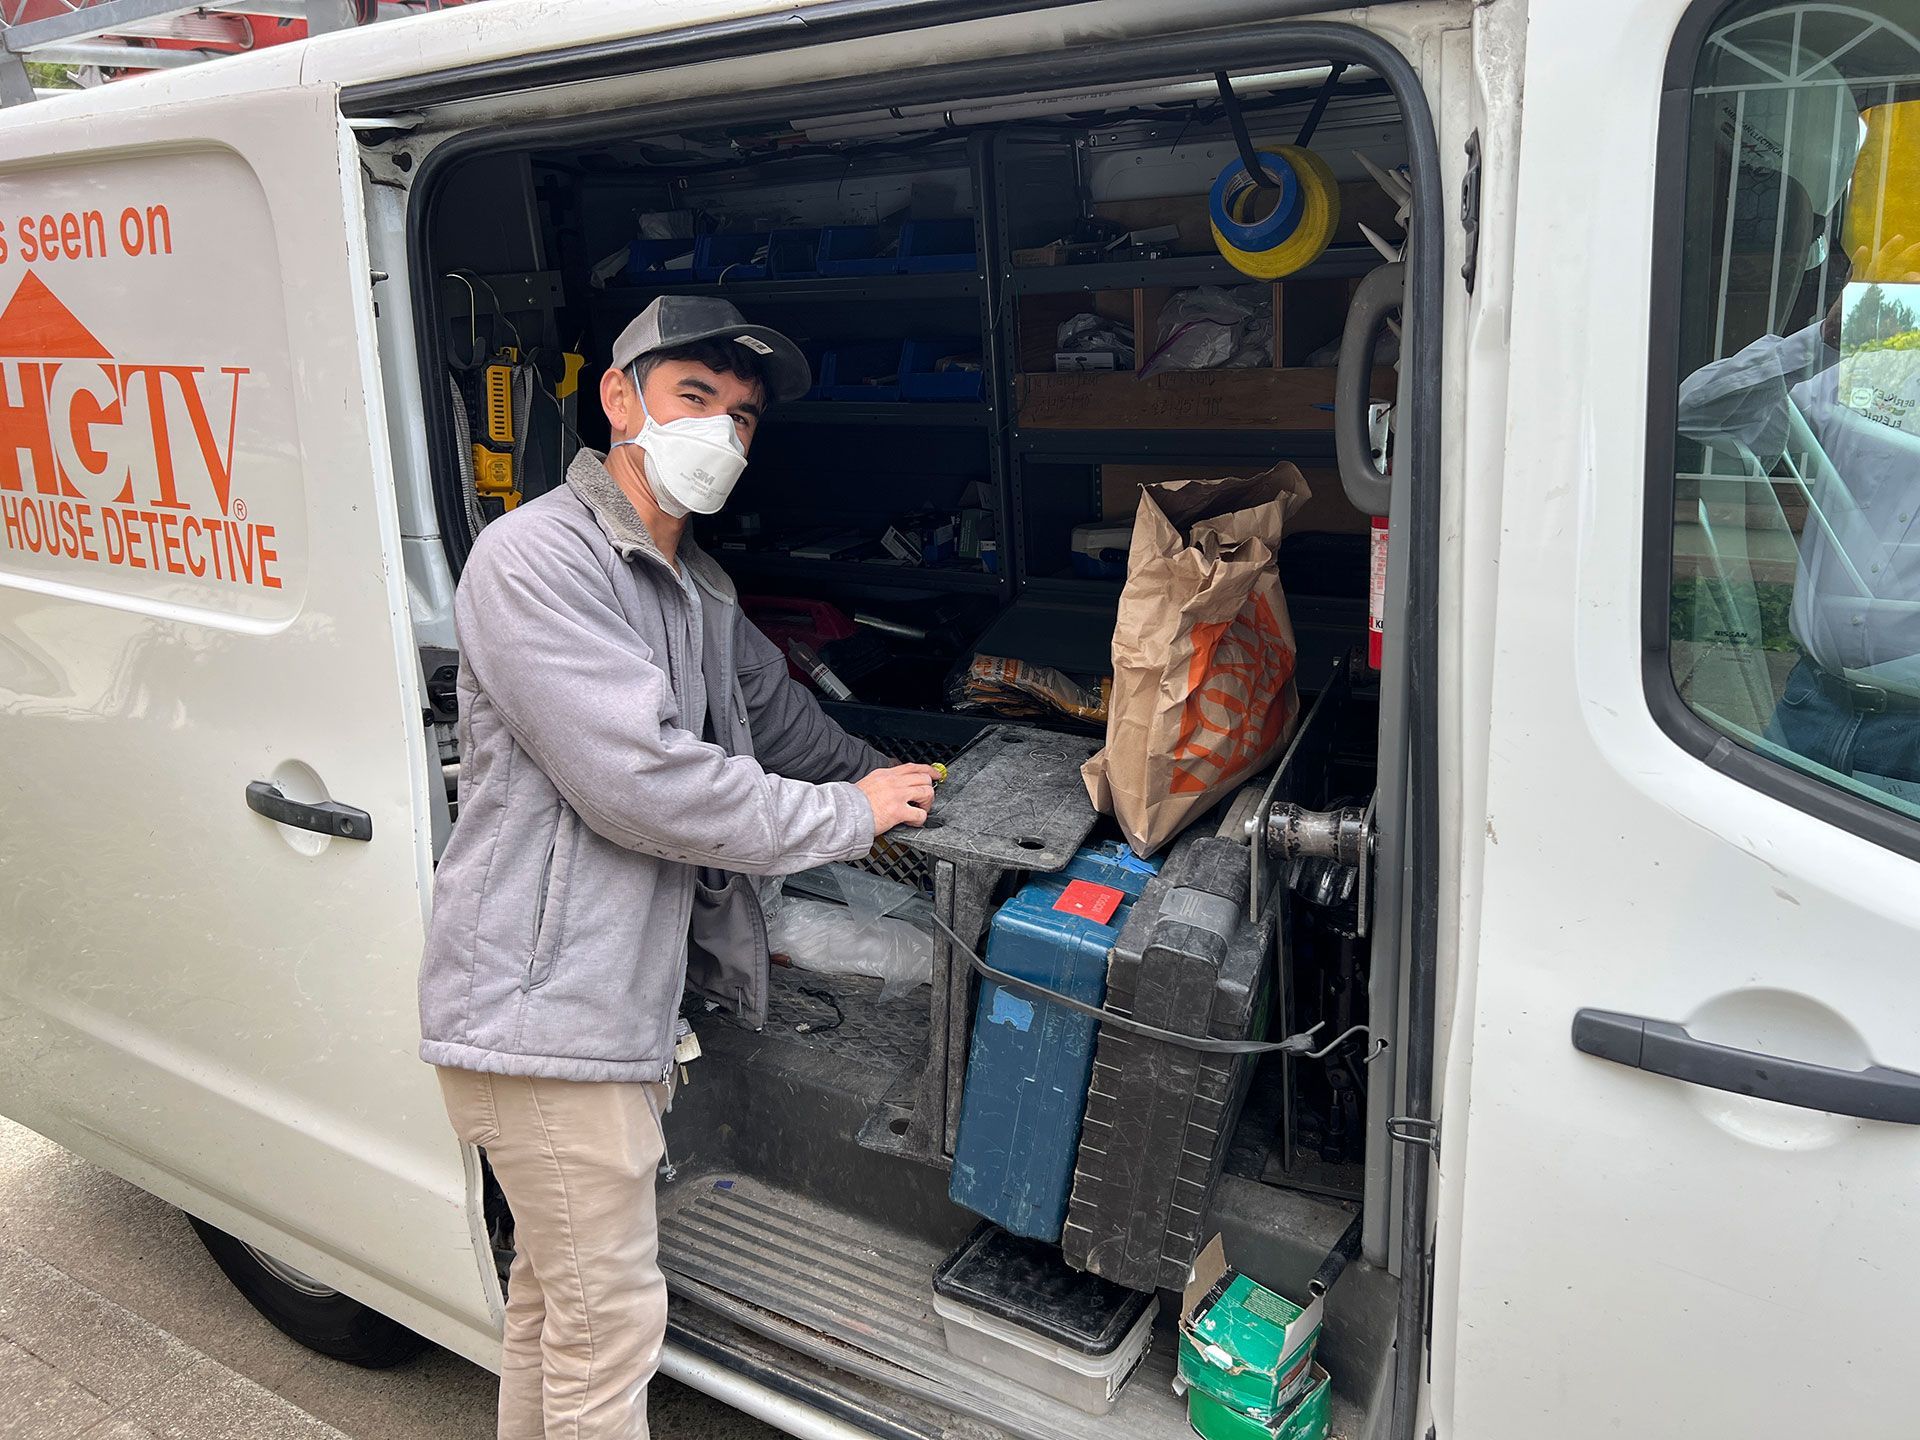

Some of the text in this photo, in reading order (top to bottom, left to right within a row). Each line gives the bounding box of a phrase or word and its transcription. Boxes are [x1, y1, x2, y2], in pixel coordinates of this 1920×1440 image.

[18, 210, 107, 263] seen
[119, 204, 172, 257] on
[0, 362, 250, 517] HGTV
[693, 469, 716, 486] 3M
[1, 495, 283, 589] HOUSE DETECTIVE
[1714, 630, 1747, 638] NISSAN
